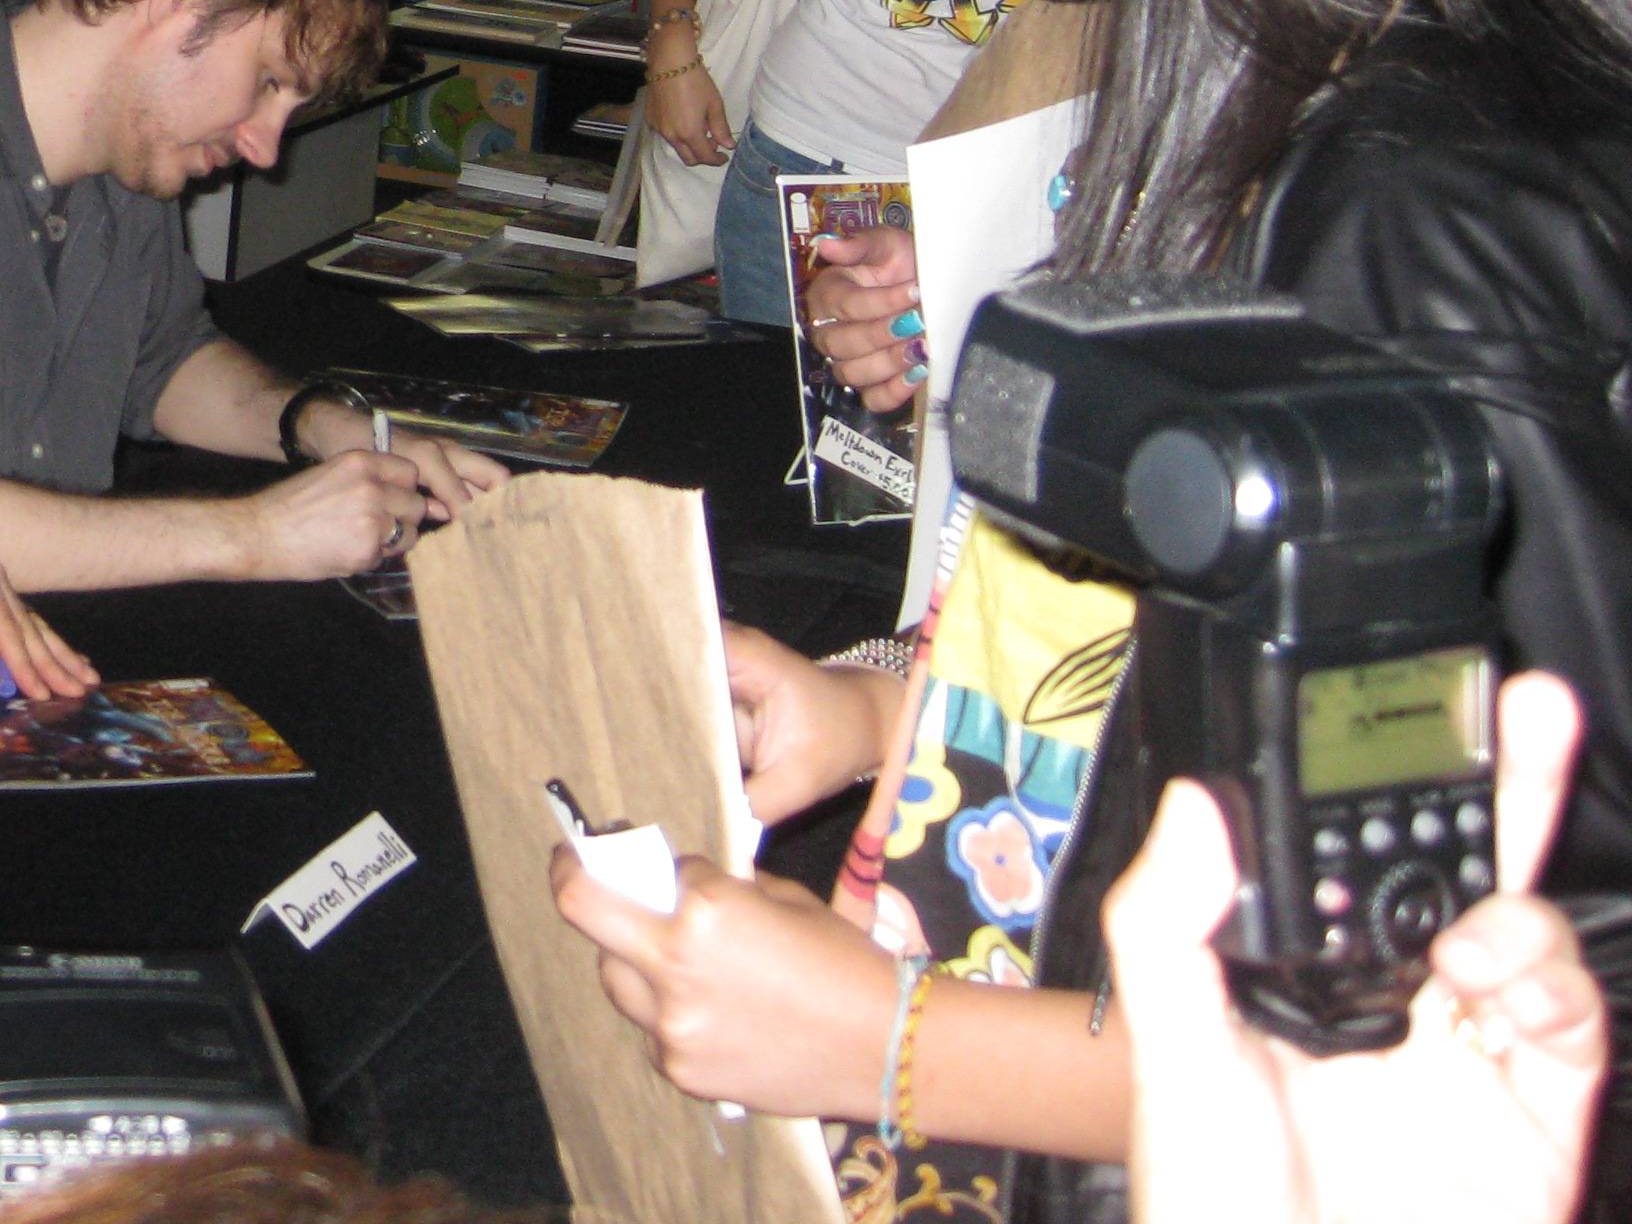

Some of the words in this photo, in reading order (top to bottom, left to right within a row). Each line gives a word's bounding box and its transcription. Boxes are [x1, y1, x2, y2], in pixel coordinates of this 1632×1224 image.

[824, 420, 883, 465] Meltdown
[282, 888, 345, 931] Darren
[330, 831, 409, 897] Romanelli
